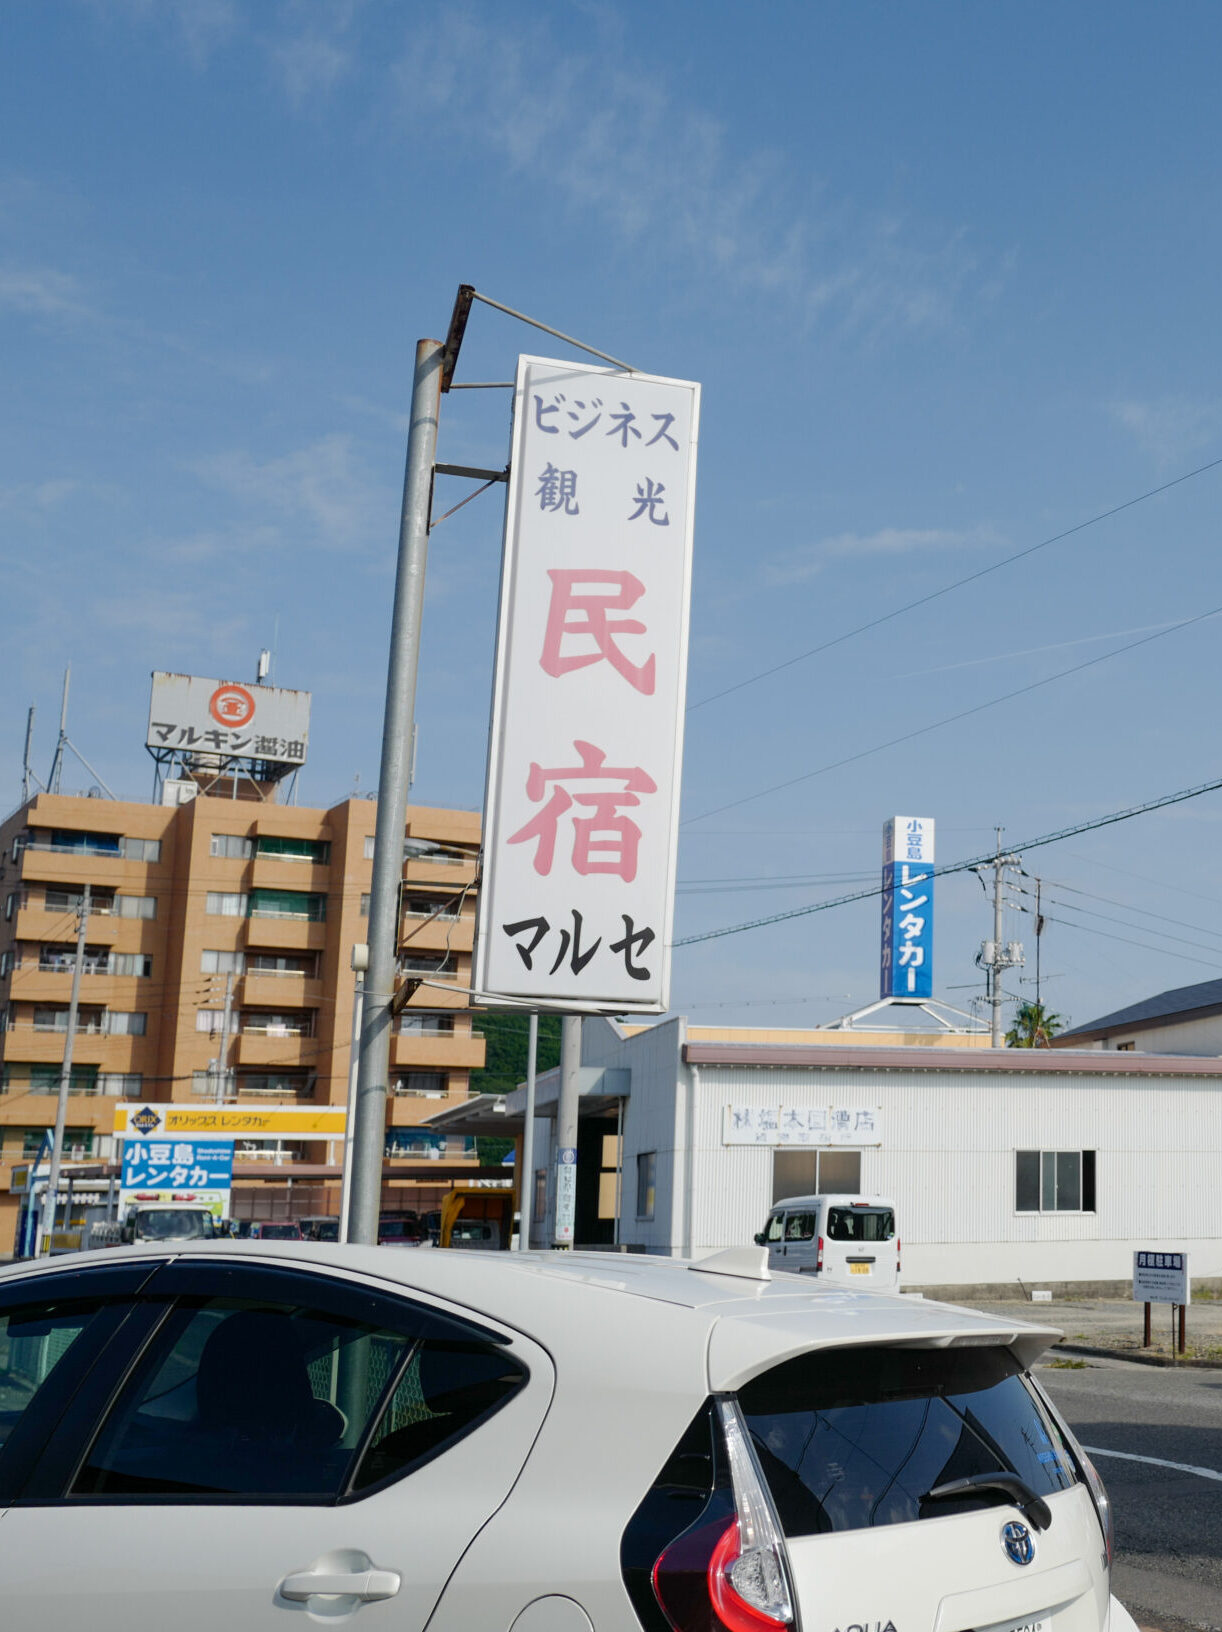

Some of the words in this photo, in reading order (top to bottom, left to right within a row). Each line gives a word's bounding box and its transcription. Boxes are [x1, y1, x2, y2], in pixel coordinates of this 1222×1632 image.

[533, 392, 680, 452] ビジネス
[507, 568, 658, 883] 民宿
[906, 819, 923, 860] 小豆島
[503, 909, 657, 980] マルセ
[899, 865, 928, 992] レンタカー
[169, 1115, 217, 1127] オリックス
[221, 1116, 271, 1127] レンタカー
[125, 1143, 194, 1165] 小豆島
[125, 1166, 229, 1187] レンタカー
